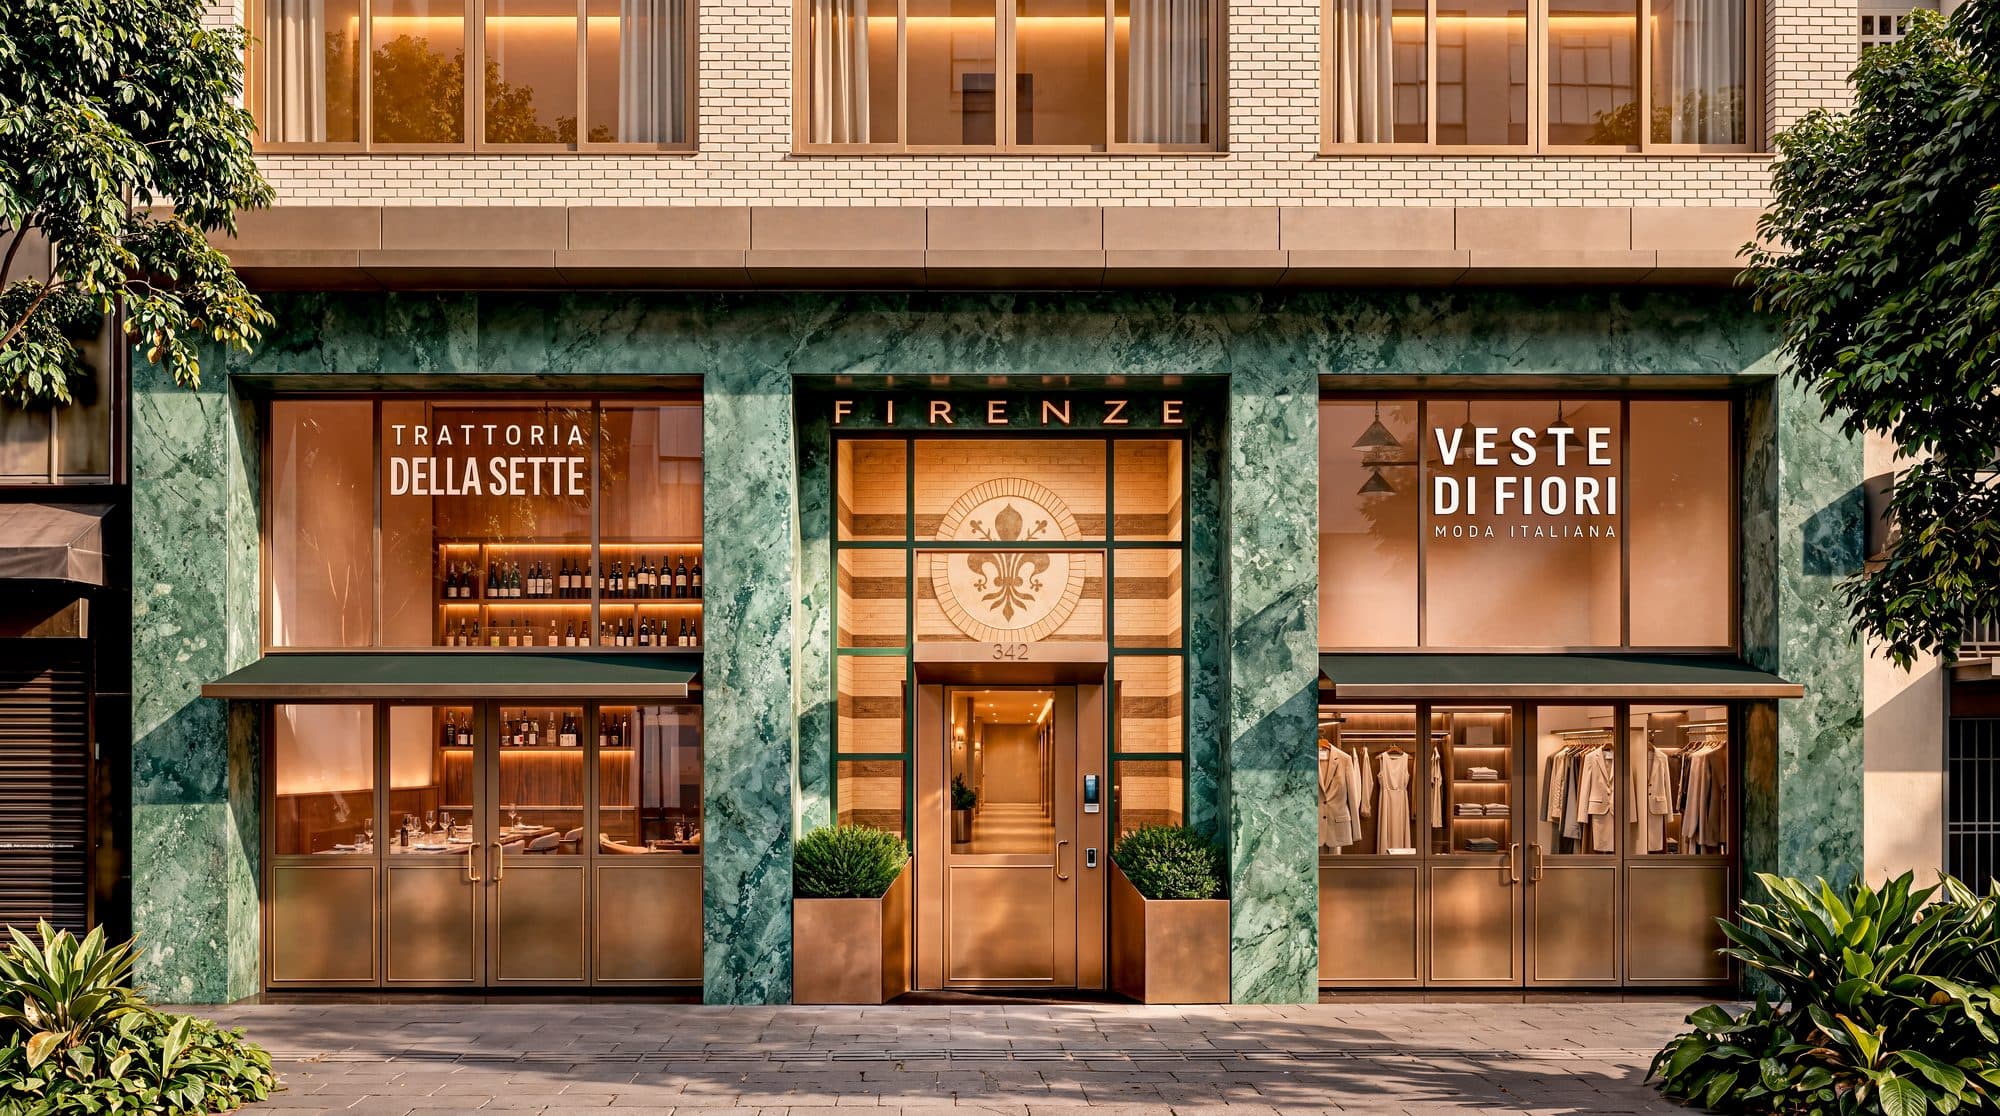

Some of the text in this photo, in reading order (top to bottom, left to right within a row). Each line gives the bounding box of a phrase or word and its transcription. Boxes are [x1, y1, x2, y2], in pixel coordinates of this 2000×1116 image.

[835, 400, 1183, 424] FIRENZE
[391, 424, 584, 446] TRATTORIA
[1434, 427, 1612, 467] VESTE
[390, 456, 585, 496] DELLA SETTE
[1434, 476, 1617, 515] DI FIORI
[1435, 525, 1616, 538] MODA ITALIANA
[992, 643, 1029, 660] 342
